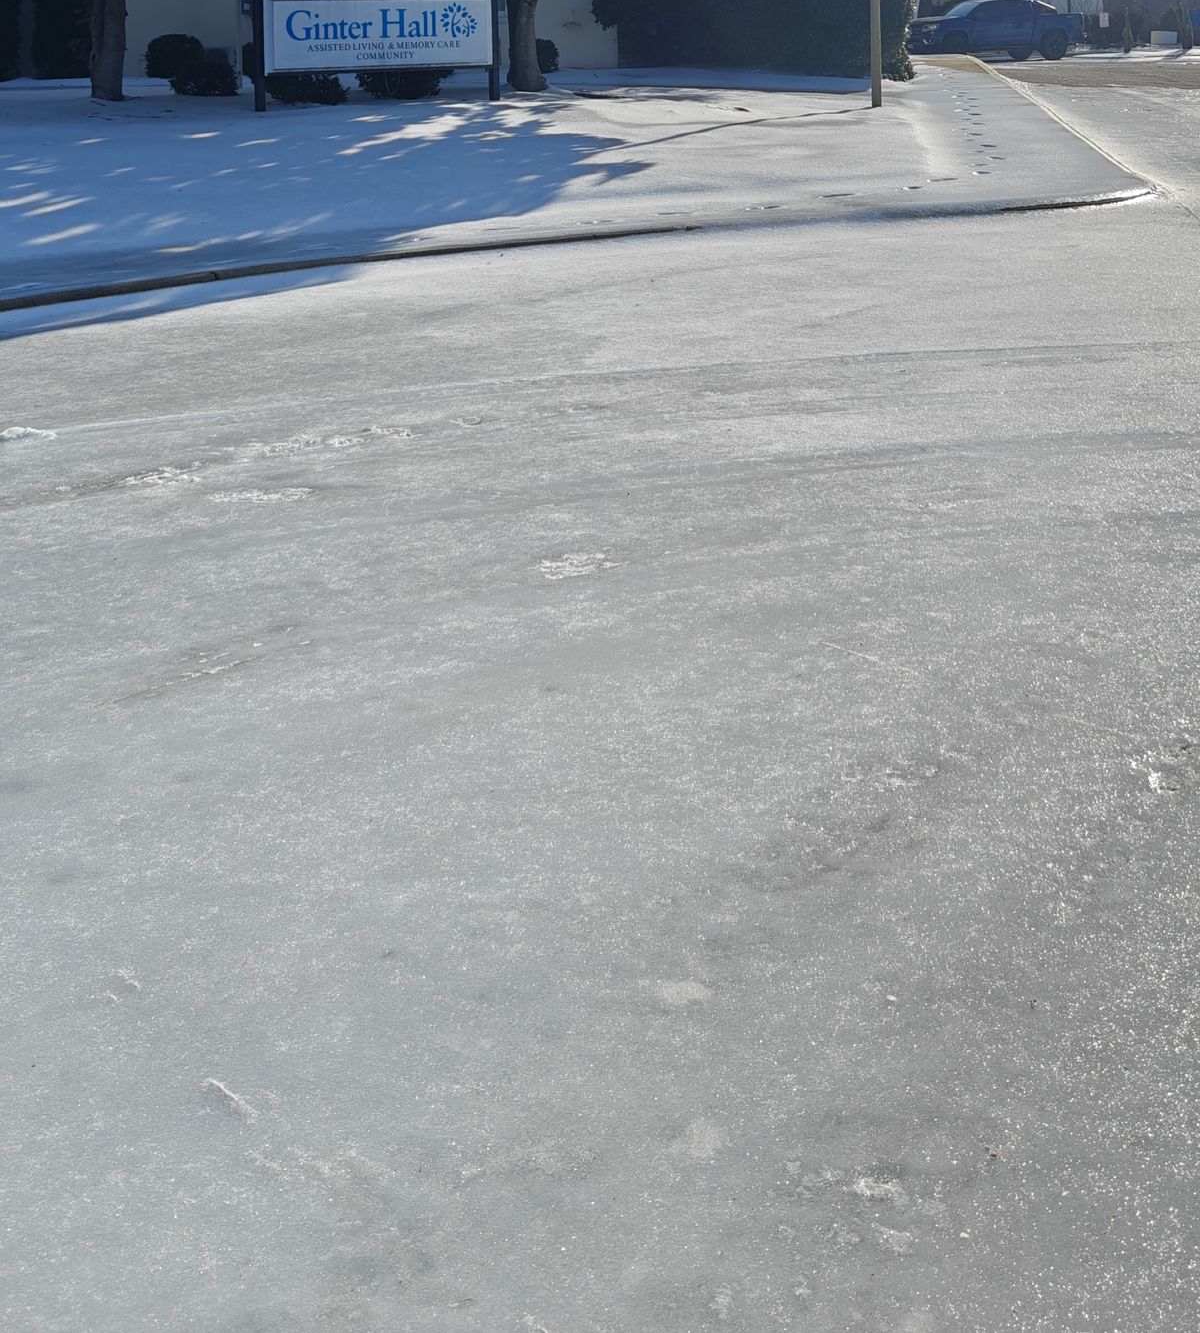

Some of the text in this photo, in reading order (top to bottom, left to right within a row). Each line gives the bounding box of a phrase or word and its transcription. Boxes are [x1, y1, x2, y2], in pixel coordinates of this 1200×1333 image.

[286, 8, 438, 41] Ginter Hall
[307, 40, 461, 52] ASSISTED LIVING & MEMORY CARE
[356, 51, 415, 61] COMMUNITY
